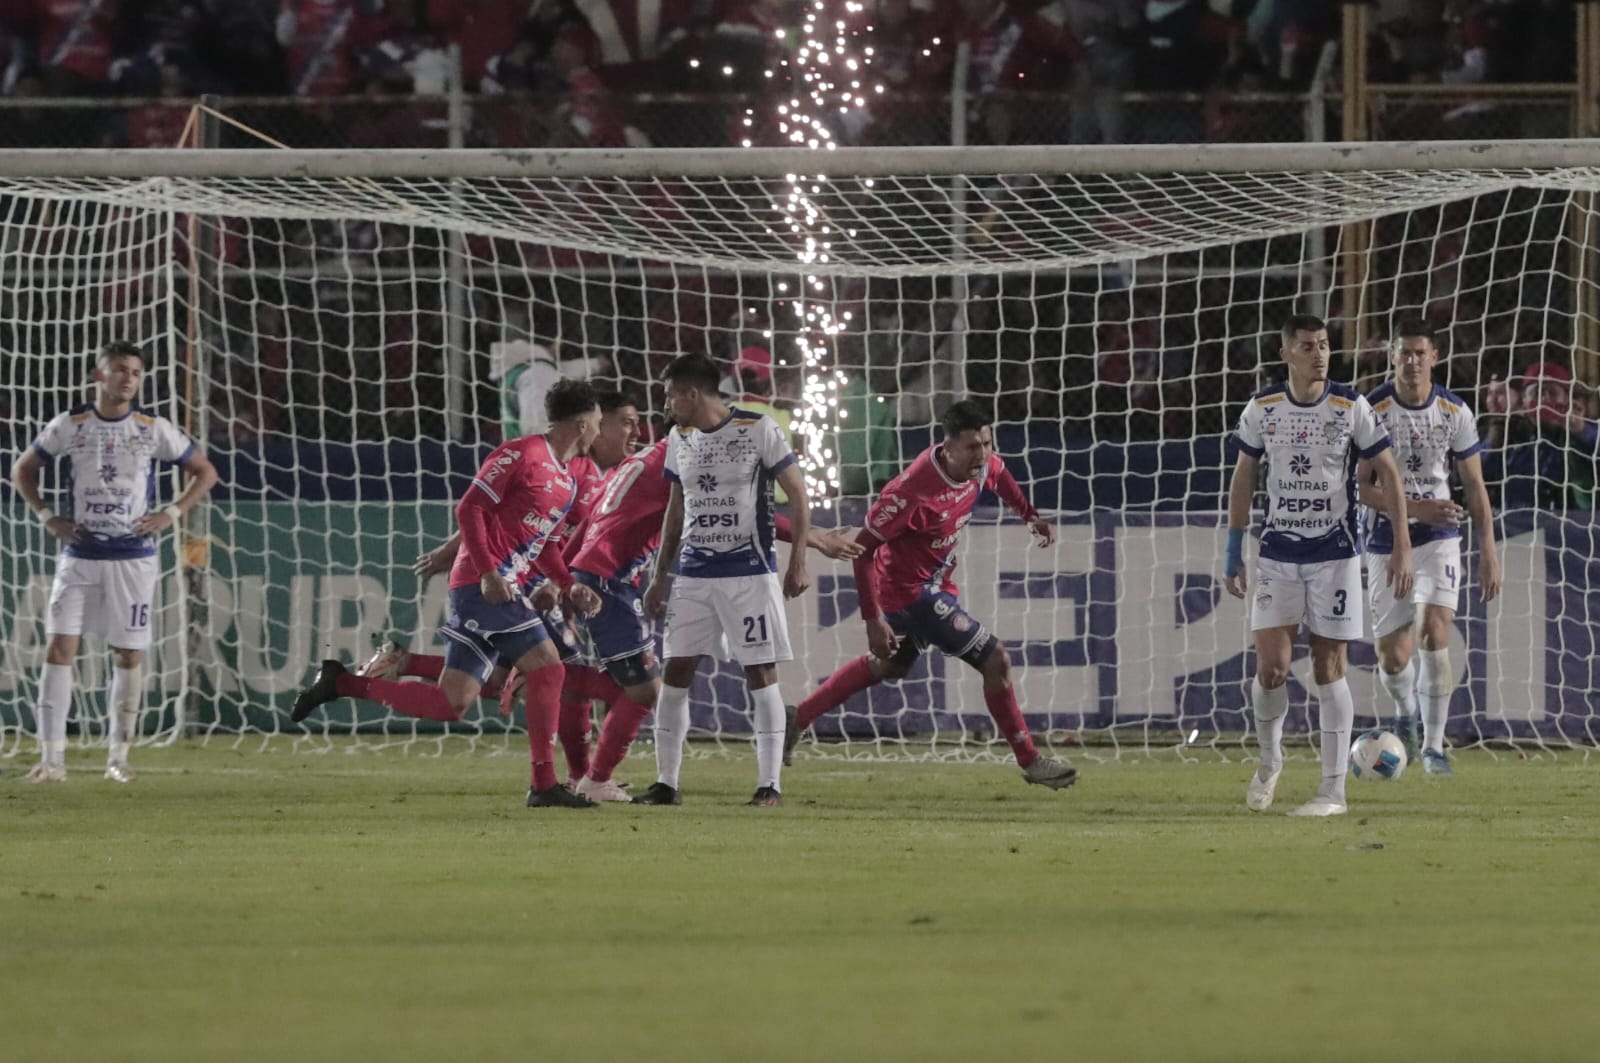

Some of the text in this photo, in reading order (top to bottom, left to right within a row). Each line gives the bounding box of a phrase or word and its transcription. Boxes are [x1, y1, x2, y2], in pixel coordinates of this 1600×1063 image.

[1279, 480, 1328, 491] BANTRAB
[1277, 497, 1331, 513] PEPSI
[1445, 564, 1456, 588] 4
[1332, 589, 1347, 616] 3
[130, 603, 148, 627] 16
[743, 614, 767, 643] 21
